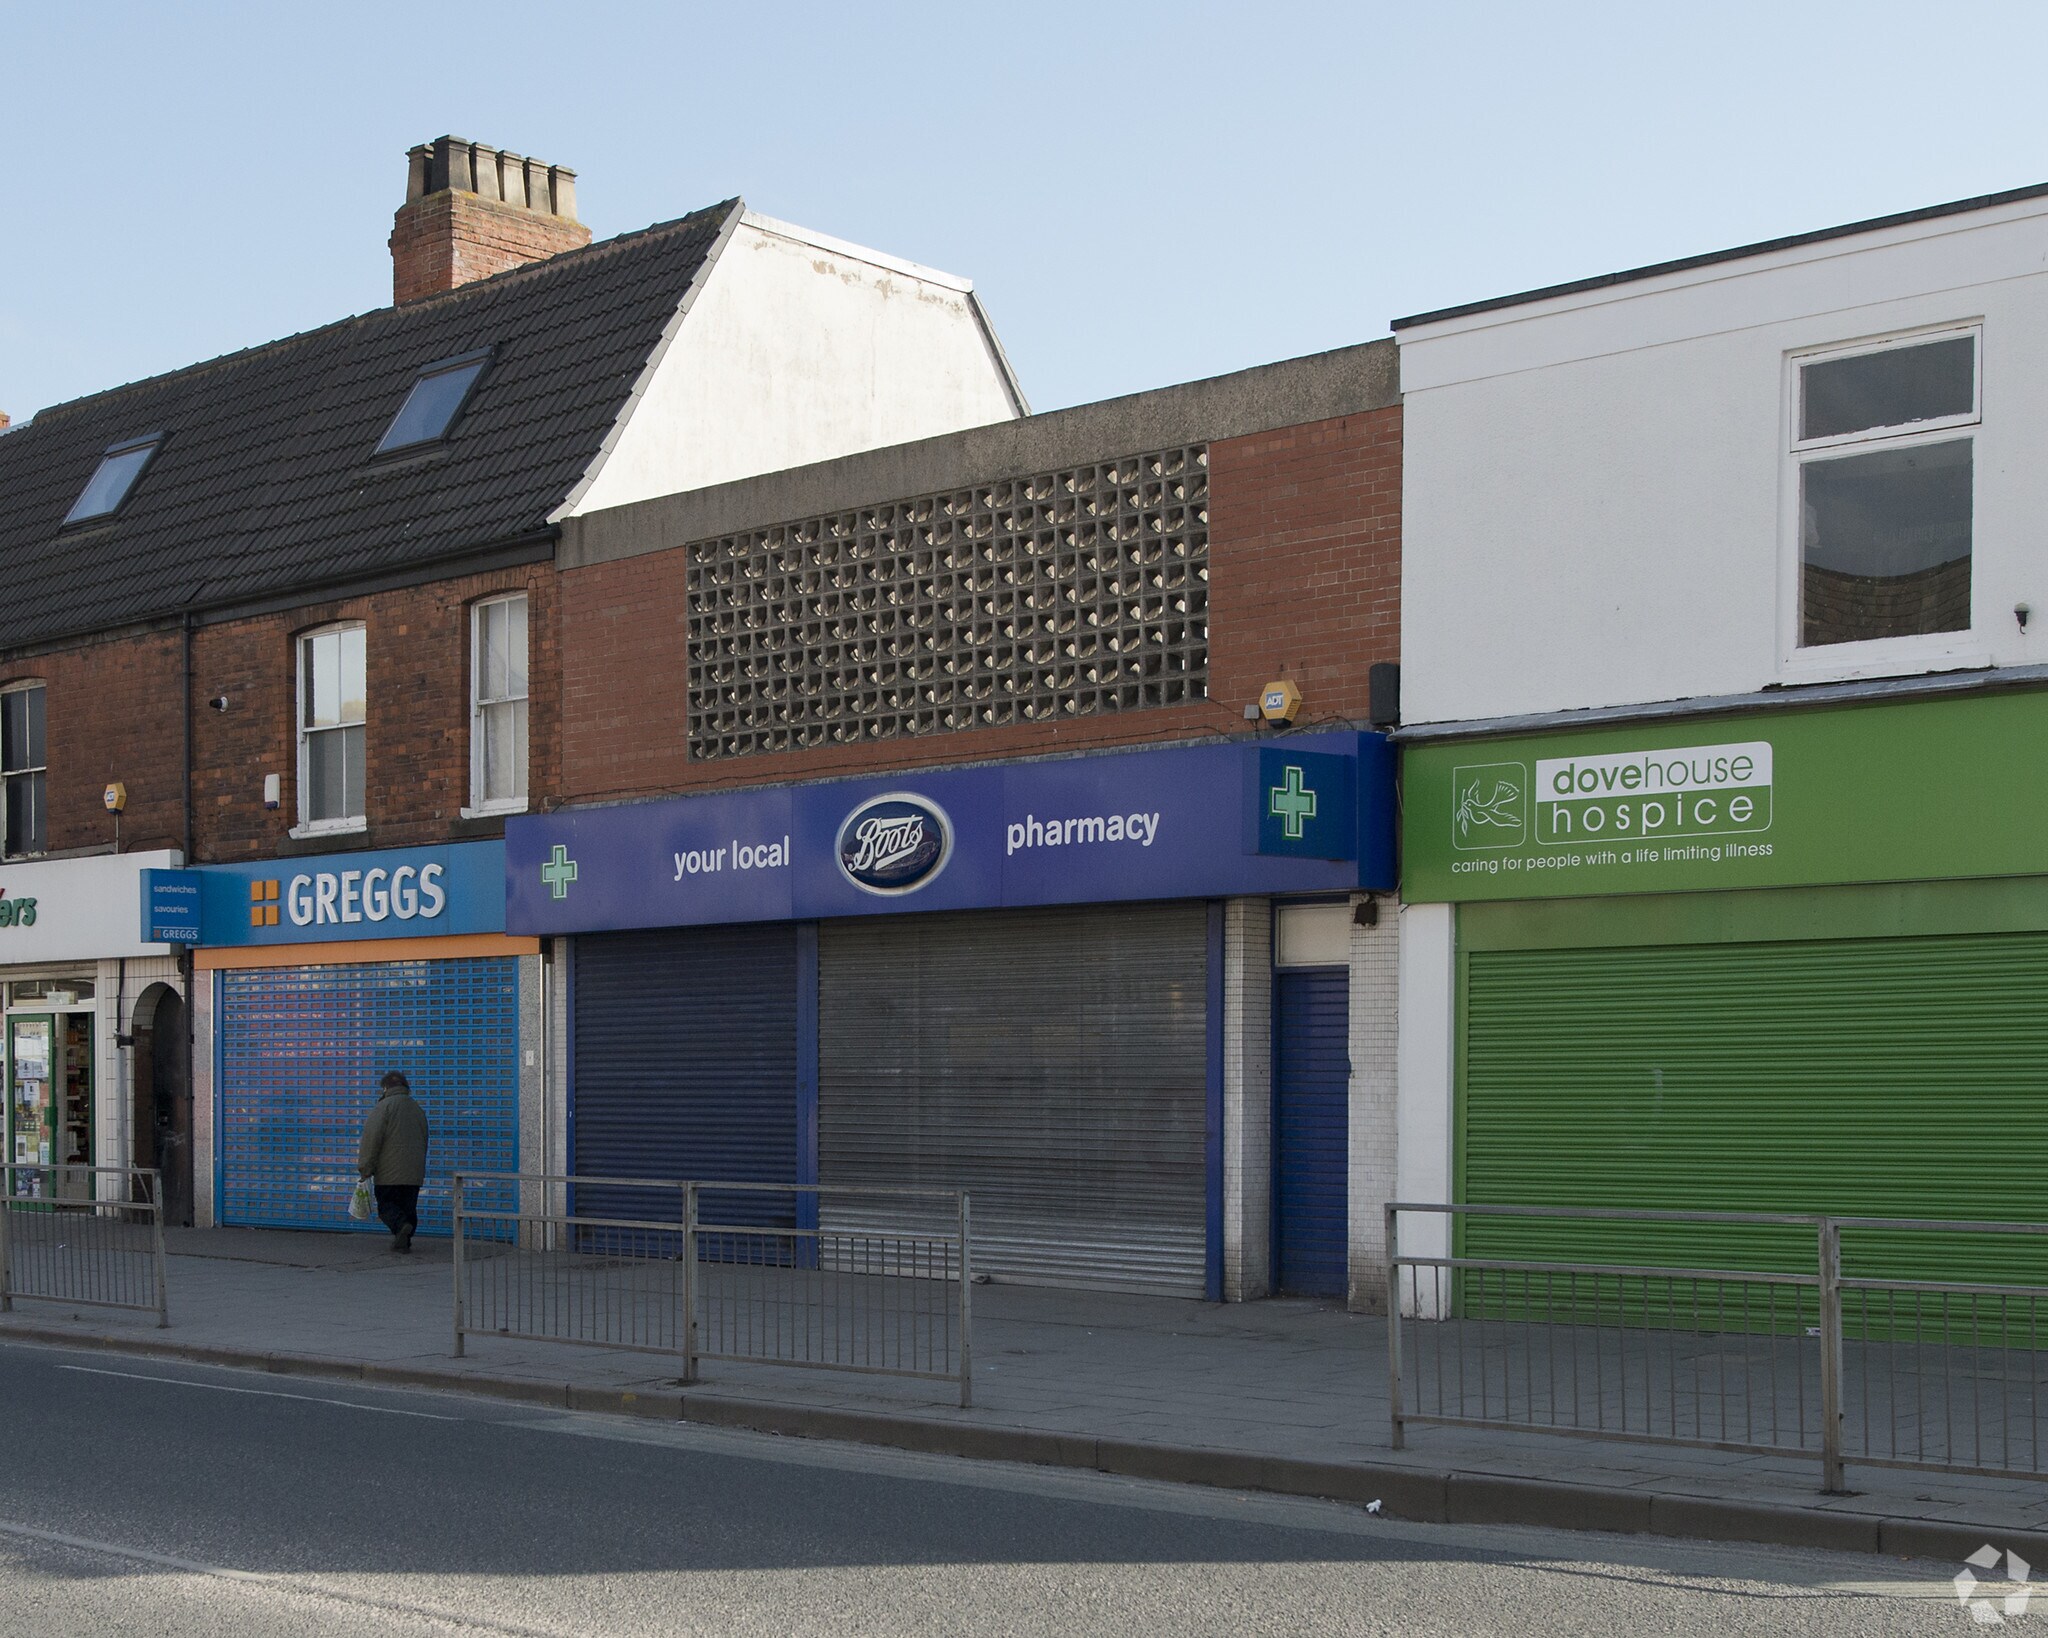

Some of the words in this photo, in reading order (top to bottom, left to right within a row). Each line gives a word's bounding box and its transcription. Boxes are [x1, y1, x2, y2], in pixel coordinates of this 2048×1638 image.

[1553, 755, 1754, 795] dovehouse
[1007, 812, 1160, 856] pharmacy
[1552, 793, 1754, 836] hospice
[674, 847, 727, 882] your
[732, 834, 790, 871] local
[848, 814, 924, 872] Boots
[1451, 858, 1499, 875] caring
[1502, 856, 1523, 870] for
[1526, 853, 1581, 872] people
[1585, 850, 1617, 866] with
[1621, 852, 1632, 864] a
[1636, 849, 1659, 863] life
[1663, 845, 1721, 862] limiting
[1725, 843, 1773, 858] illness
[153, 885, 197, 894] sandwiches
[153, 905, 189, 914] savouries
[288, 863, 446, 926] GREGGS
[162, 929, 198, 940] GREGGS
